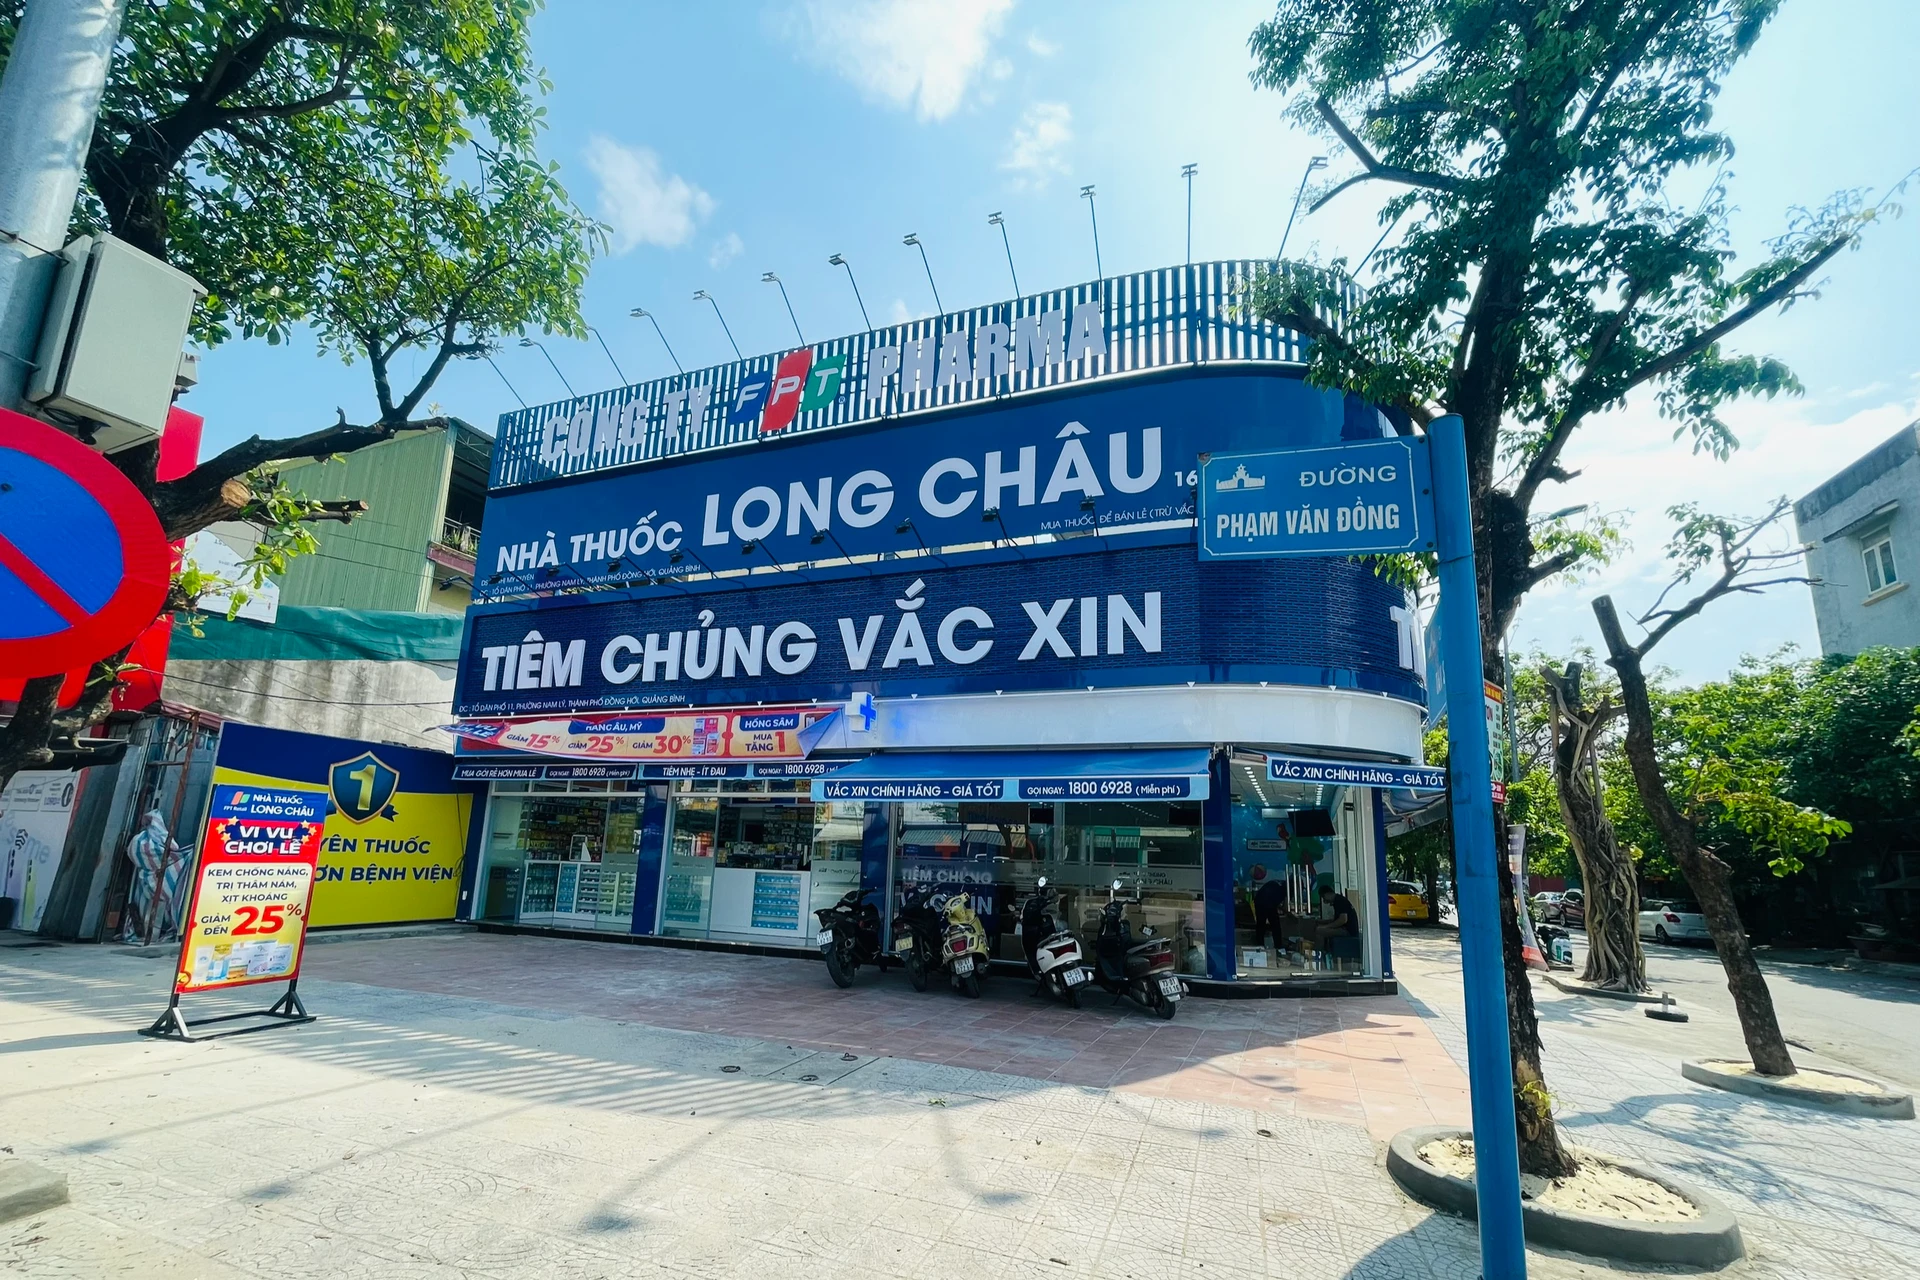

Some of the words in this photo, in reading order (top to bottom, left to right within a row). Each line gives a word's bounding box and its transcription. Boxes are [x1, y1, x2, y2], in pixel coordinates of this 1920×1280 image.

[542, 401, 648, 462] CÔNG
[663, 384, 713, 438] TY
[730, 356, 844, 422] FPT
[867, 301, 1107, 399] PHARMA
[702, 470, 894, 546] LONG
[919, 420, 1162, 518] CHÂU
[1299, 462, 1397, 487] ĐƯỜNG
[1041, 519, 1061, 531] MUA
[1064, 514, 1096, 527] THUỐC
[1099, 509, 1112, 524] ĐỂ
[1114, 509, 1135, 522] BÁN
[1174, 502, 1195, 515] VẮC
[1216, 511, 1278, 542] PHẠM
[1285, 504, 1329, 535] VĂN
[1337, 496, 1400, 532] ĐỒNG
[496, 530, 559, 572] NHÀ
[570, 509, 683, 563] THUỐC
[482, 630, 586, 692] TIÊM
[601, 609, 818, 685] CHỦNG
[838, 578, 995, 671] VẮC
[1017, 591, 1162, 661] XIN
[542, 700, 558, 709] NAM
[629, 721, 643, 731] MỸ
[745, 717, 772, 728] HỒNG
[773, 716, 794, 727] SÂM
[526, 733, 561, 749] 15%
[585, 735, 625, 753] 25%
[632, 741, 653, 749] GIẢM
[653, 735, 692, 754] 30%
[745, 741, 774, 754] TẶNG
[775, 731, 786, 752] 1
[753, 733, 773, 741] MUA
[572, 767, 588, 776] 1800
[588, 767, 606, 776] 6928
[662, 765, 680, 776] TIÊM
[701, 763, 710, 776] ÍT
[710, 766, 727, 776] ĐAU
[784, 764, 803, 774] 1800
[804, 764, 825, 774] 6928
[1274, 760, 1301, 778] VẮC
[1302, 767, 1323, 779] XIN
[1324, 766, 1360, 782] CHÍNH
[1361, 769, 1393, 783] HÃNG
[1403, 771, 1423, 785] GIÁ
[1424, 772, 1444, 786] TỐT
[826, 782, 849, 797] VẮC
[851, 785, 869, 797] XIN
[871, 782, 905, 797] CHÍNH
[909, 783, 942, 797] HÃNG
[952, 782, 972, 797] GIÁ
[976, 780, 1001, 797] TỐT
[1027, 786, 1042, 798] GỌI
[1042, 787, 1065, 796] NGAY:
[1068, 781, 1097, 795] 1800
[1100, 781, 1133, 795] 6928
[252, 793, 272, 803] NHÀ
[274, 794, 304, 805] THUỐC
[250, 804, 283, 815] LONG
[284, 805, 315, 817] CHÂU
[239, 826, 260, 838] VI
[266, 826, 295, 839] VU
[225, 840, 274, 855] CHƠI
[279, 838, 304, 854] LỄ
[363, 835, 431, 854] THUỐC
[207, 868, 233, 877] KEM
[235, 866, 275, 877] CHỐNG
[350, 862, 407, 885] BỆNH
[412, 863, 454, 884] VIỆN
[216, 882, 233, 891] TRỊ
[221, 895, 240, 905] XỊT
[241, 891, 288, 902] KHOÁNG
[200, 913, 231, 924] GIẢM
[231, 904, 302, 936] 25%
[203, 925, 229, 936] ĐẾN
